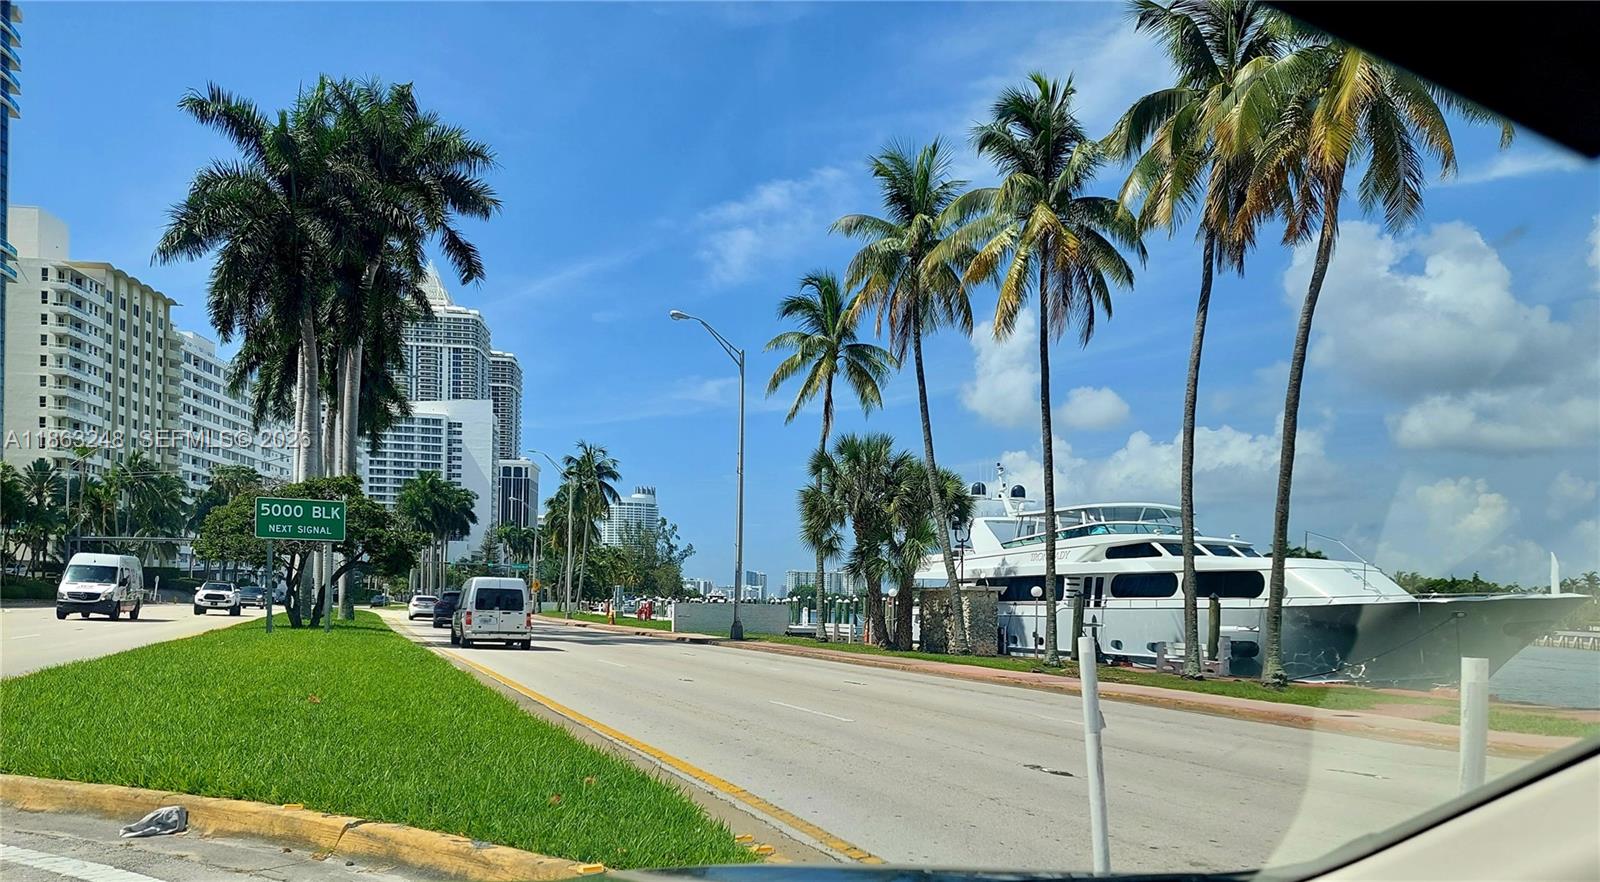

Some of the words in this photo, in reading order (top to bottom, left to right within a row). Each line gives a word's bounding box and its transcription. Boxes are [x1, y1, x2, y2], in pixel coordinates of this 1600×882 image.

[260, 503, 304, 518] 5000
[312, 506, 341, 520] BLK
[268, 524, 293, 533] NEXT
[297, 525, 332, 535] SIGNAL
[1055, 550, 1072, 560] ADY
